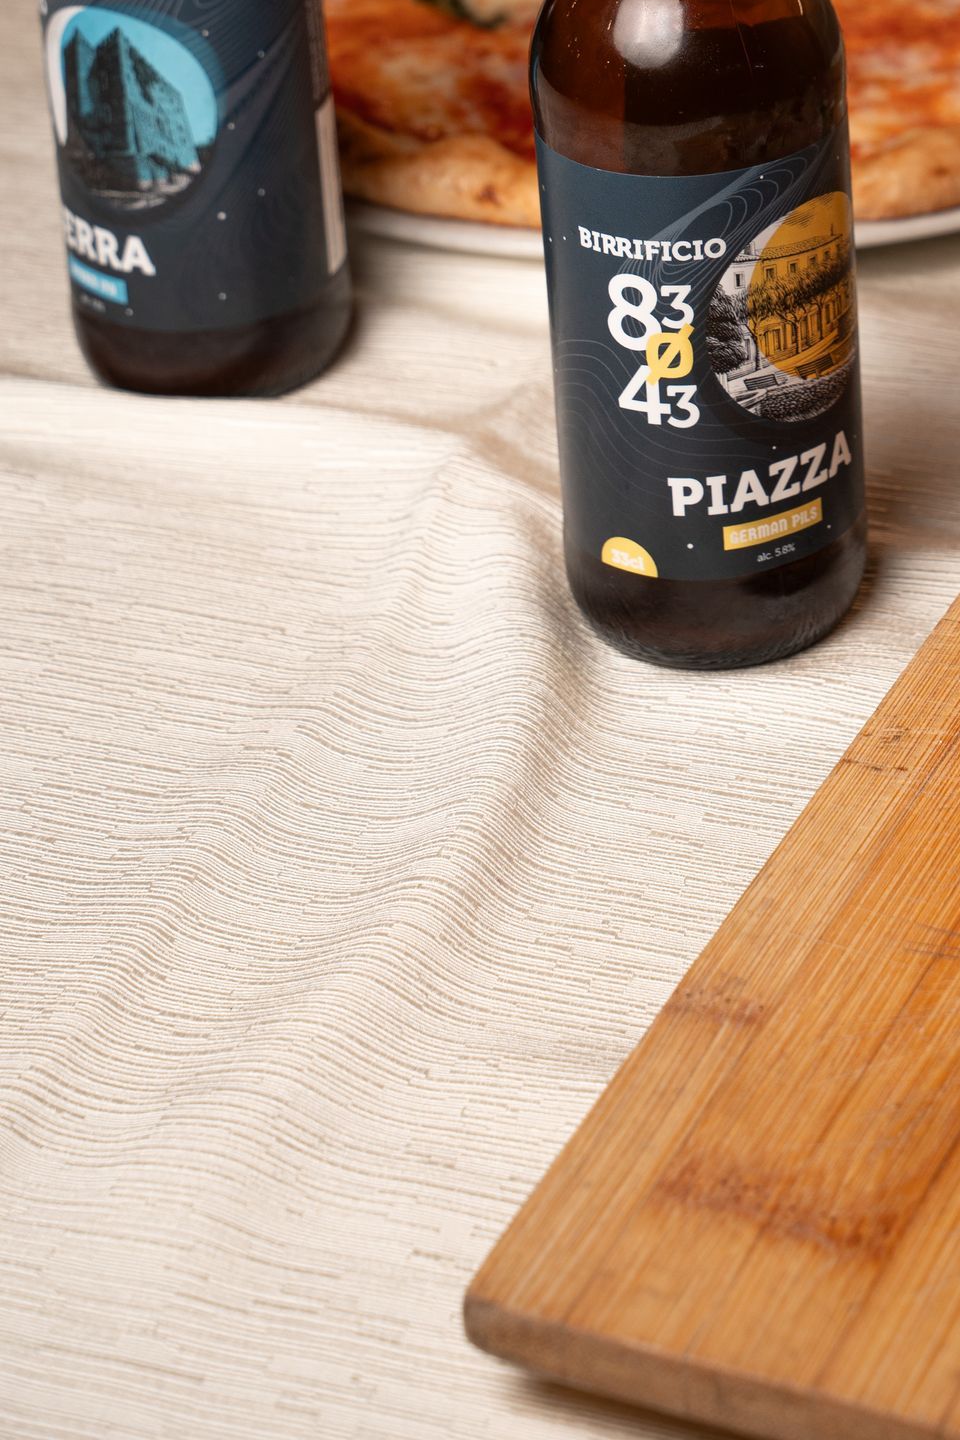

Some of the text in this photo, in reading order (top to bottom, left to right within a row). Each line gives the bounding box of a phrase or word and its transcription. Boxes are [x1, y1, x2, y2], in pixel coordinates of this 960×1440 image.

[578, 225, 727, 262] BIRRIFICIO
[667, 430, 852, 517] PIAZZA
[730, 506, 818, 545] GERMAN PILS
